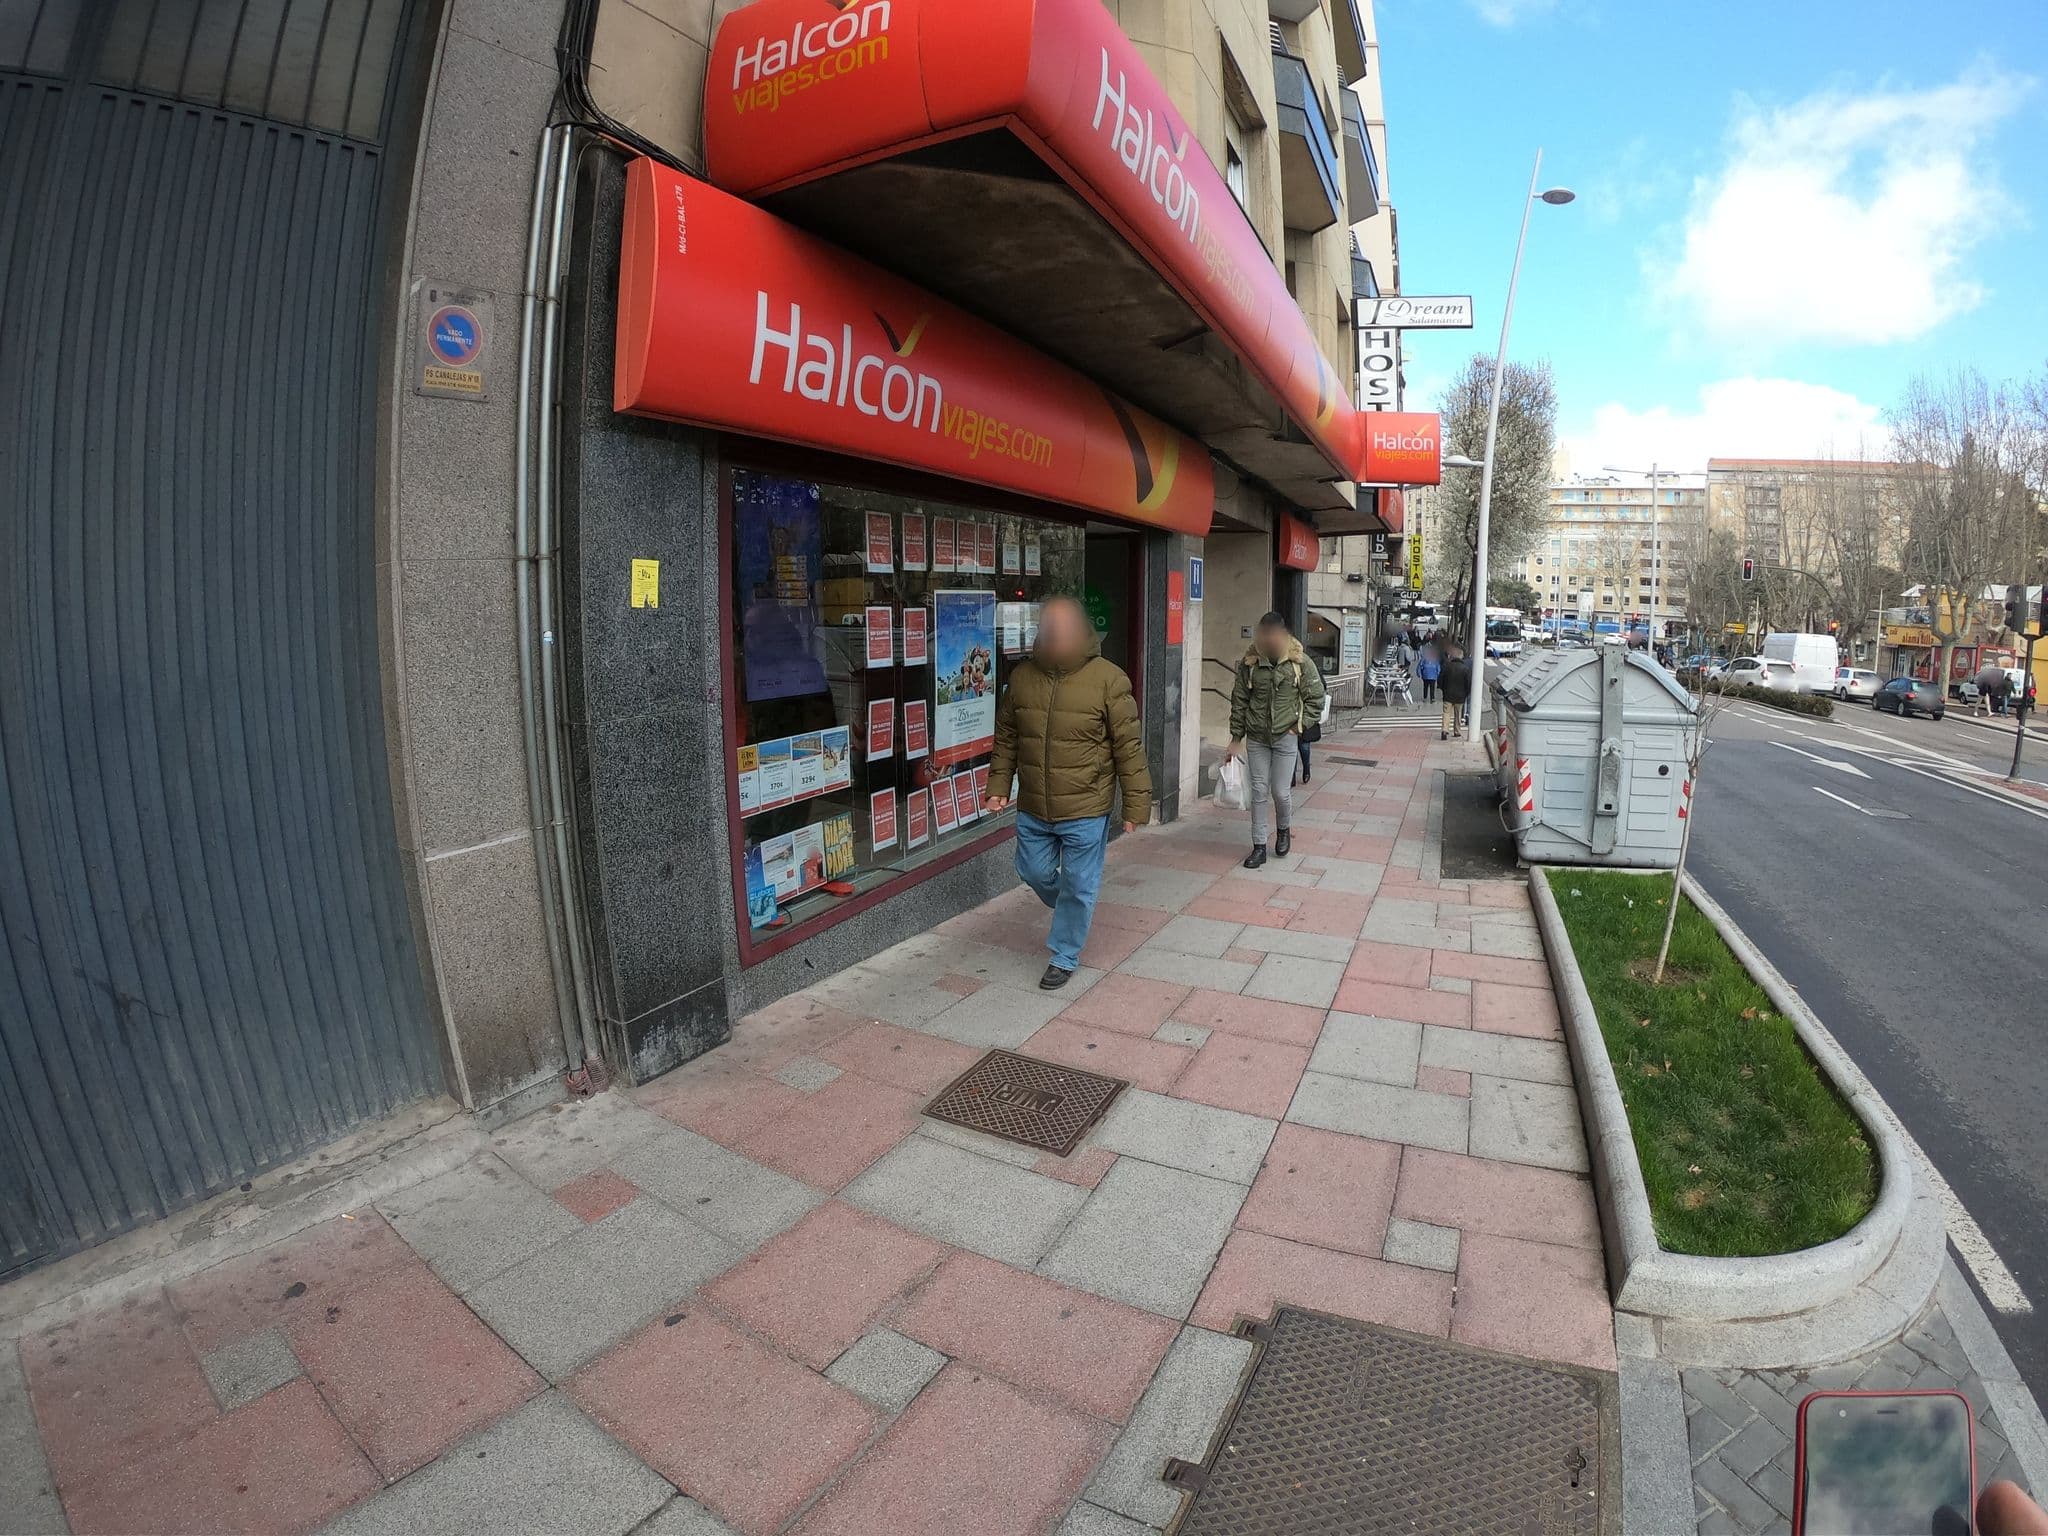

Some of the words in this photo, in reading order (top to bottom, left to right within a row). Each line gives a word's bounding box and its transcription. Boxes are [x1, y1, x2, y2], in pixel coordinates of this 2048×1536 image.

[732, 36, 889, 114] viajes.com
[1384, 299, 1464, 318] Dream
[1408, 316, 1463, 325] Salamanca
[436, 334, 472, 346] PERMANENTE
[942, 400, 1053, 468] viajes.com
[1375, 450, 1434, 462] viajes.com
[1412, 537, 1421, 589] HOSTAL
